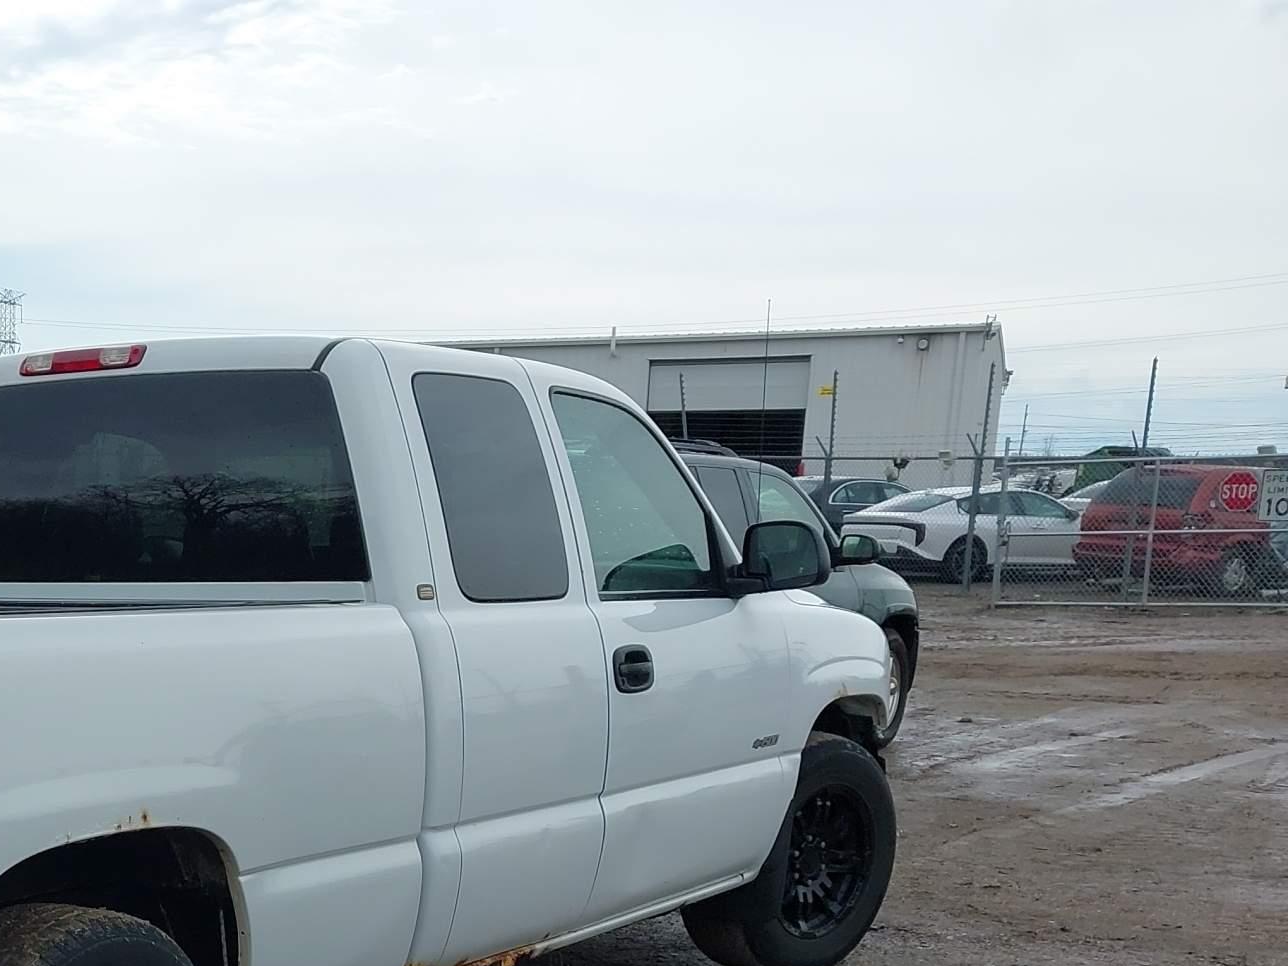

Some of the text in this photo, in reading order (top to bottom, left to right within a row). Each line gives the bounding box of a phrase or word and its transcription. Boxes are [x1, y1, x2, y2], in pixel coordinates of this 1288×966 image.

[1266, 474, 1288, 483] SPE
[1222, 484, 1258, 499] STOP
[1266, 497, 1288, 516] 10
